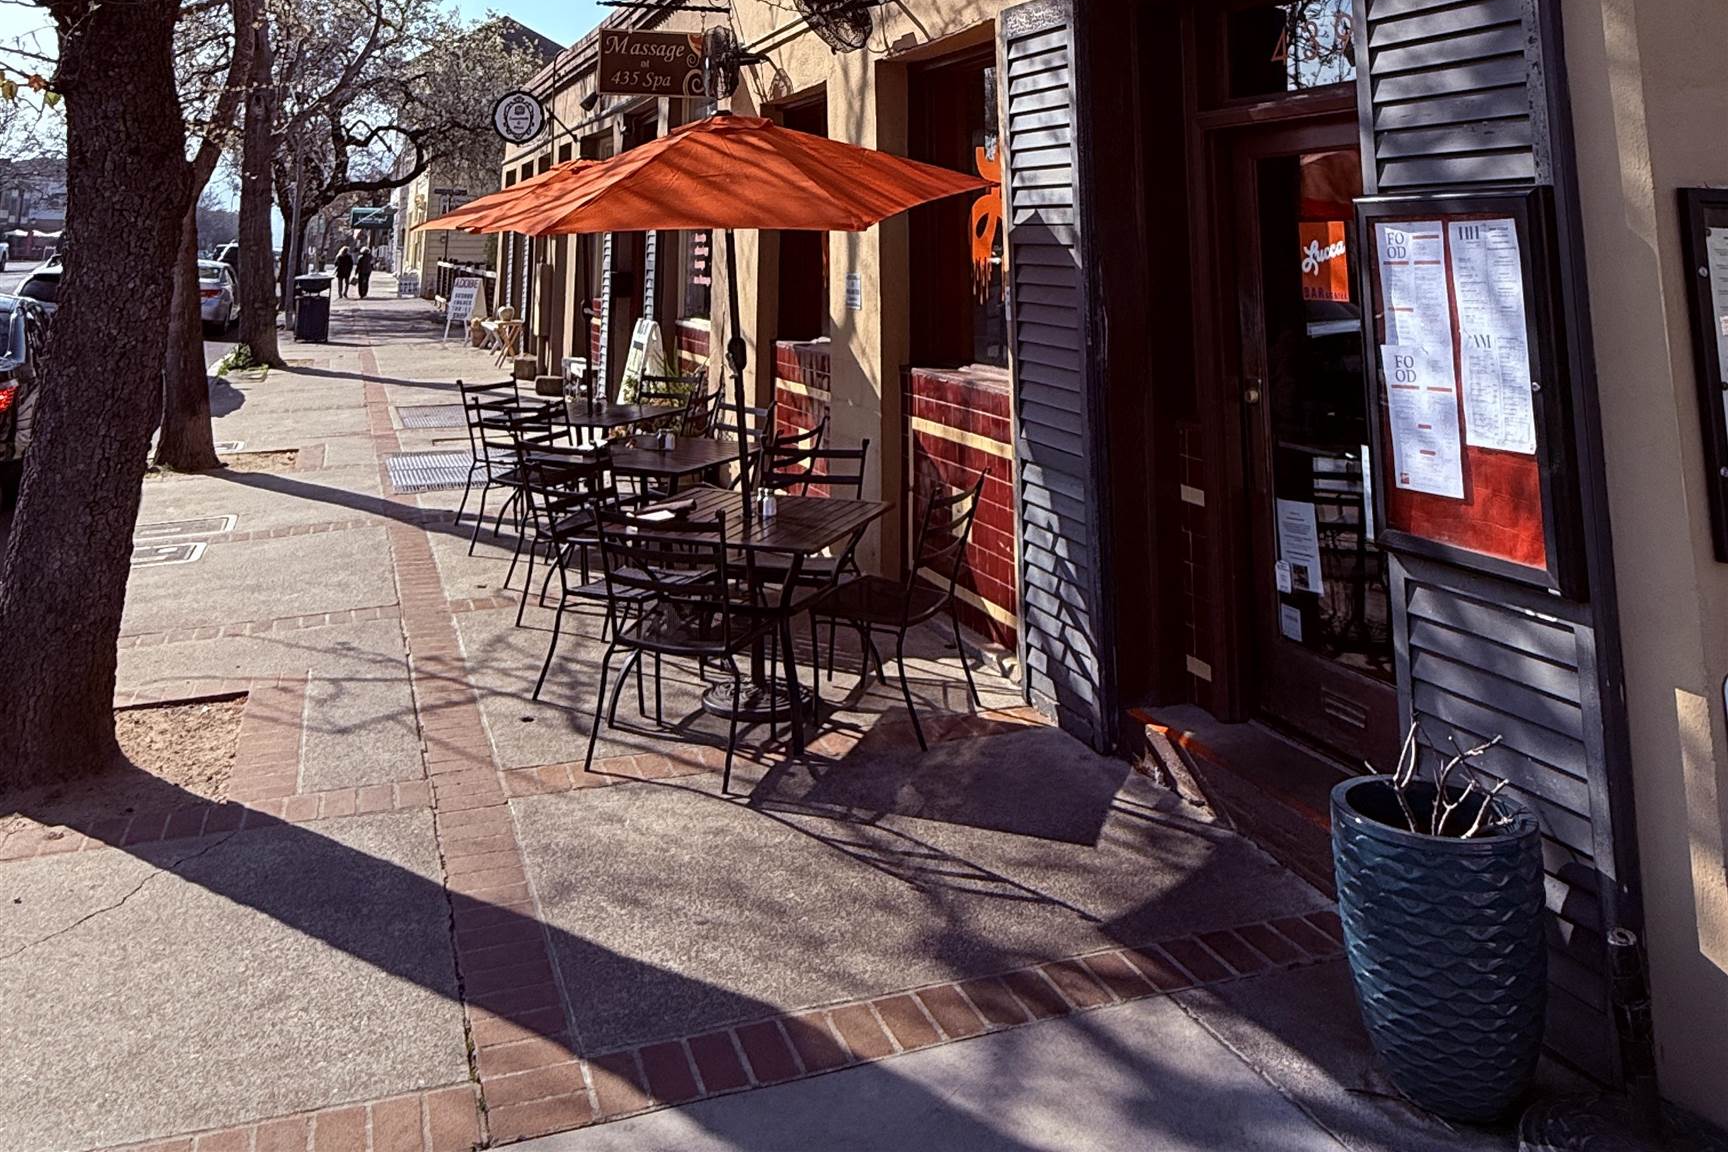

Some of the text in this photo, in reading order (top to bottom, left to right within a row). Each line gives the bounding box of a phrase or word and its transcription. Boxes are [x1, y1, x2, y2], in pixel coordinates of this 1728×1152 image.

[604, 35, 685, 62] Massage
[611, 70, 672, 90] 435 Spa
[1301, 239, 1346, 276] Lucca
